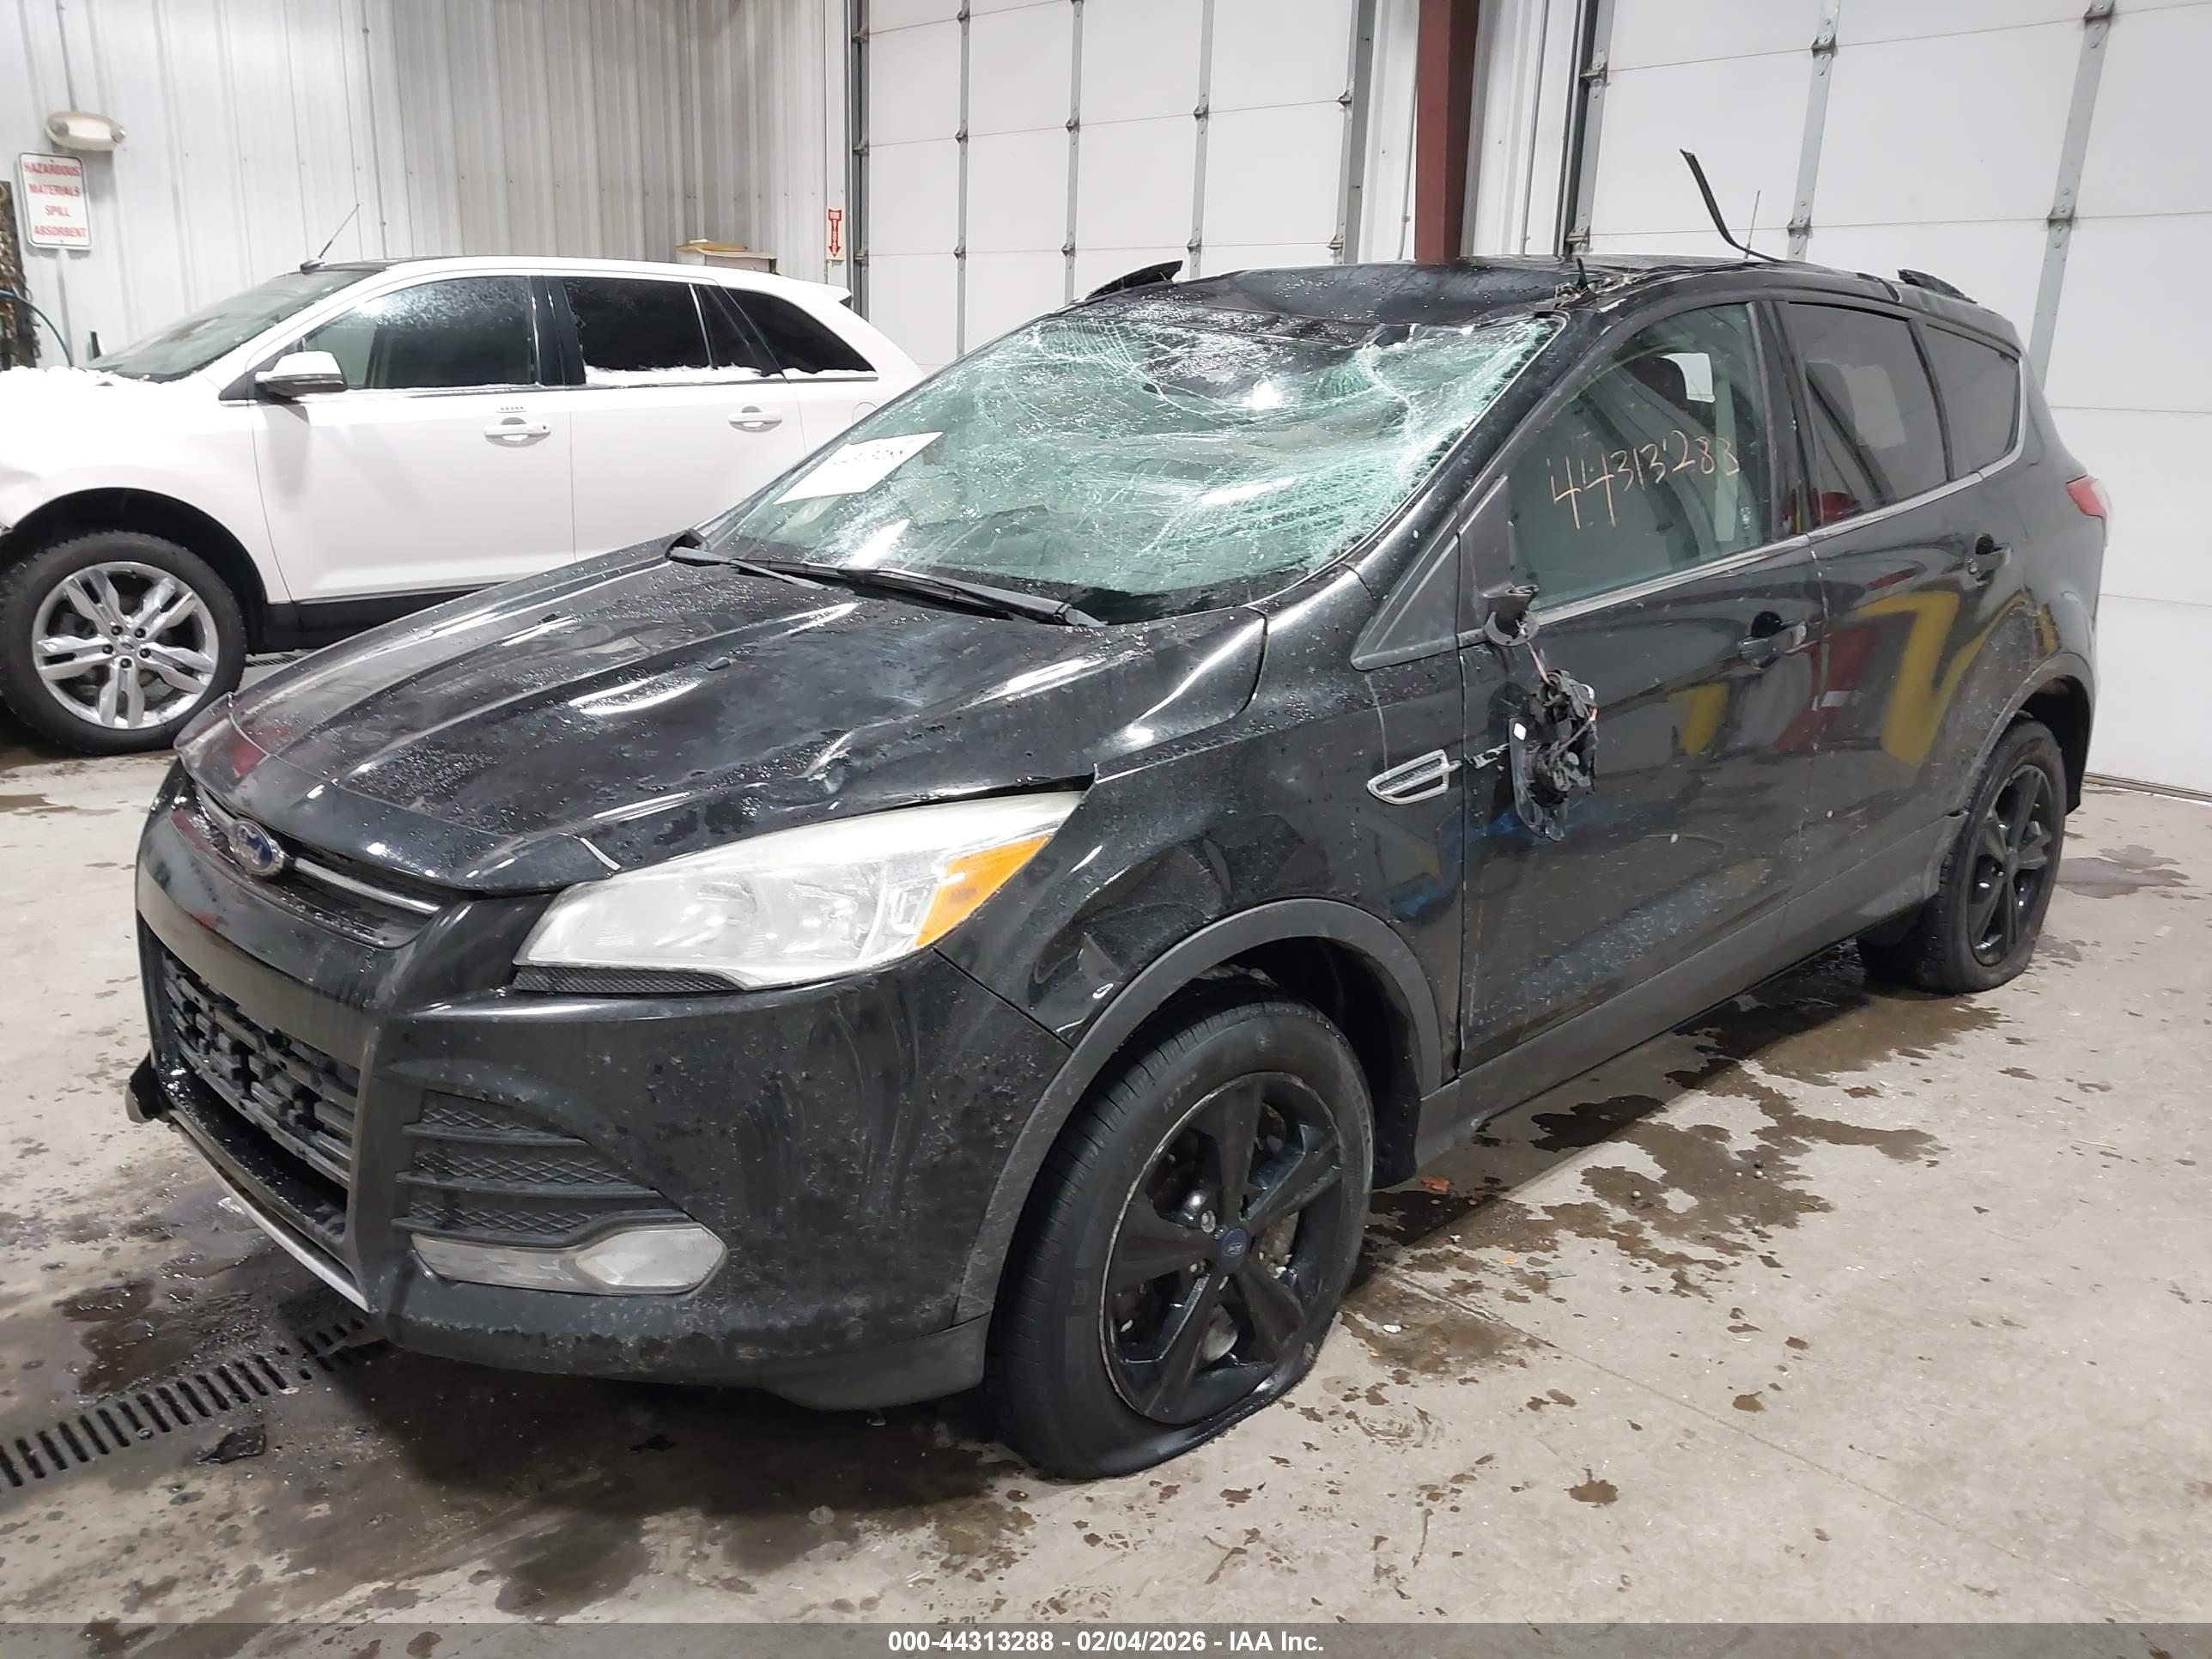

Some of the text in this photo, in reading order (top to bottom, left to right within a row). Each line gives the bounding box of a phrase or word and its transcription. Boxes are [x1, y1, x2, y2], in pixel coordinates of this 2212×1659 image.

[23, 162, 81, 177] HAZARDOUS
[28, 183, 81, 197] MATERIALS
[45, 204, 70, 217] SPILL
[33, 225, 87, 238] ABSORBENT
